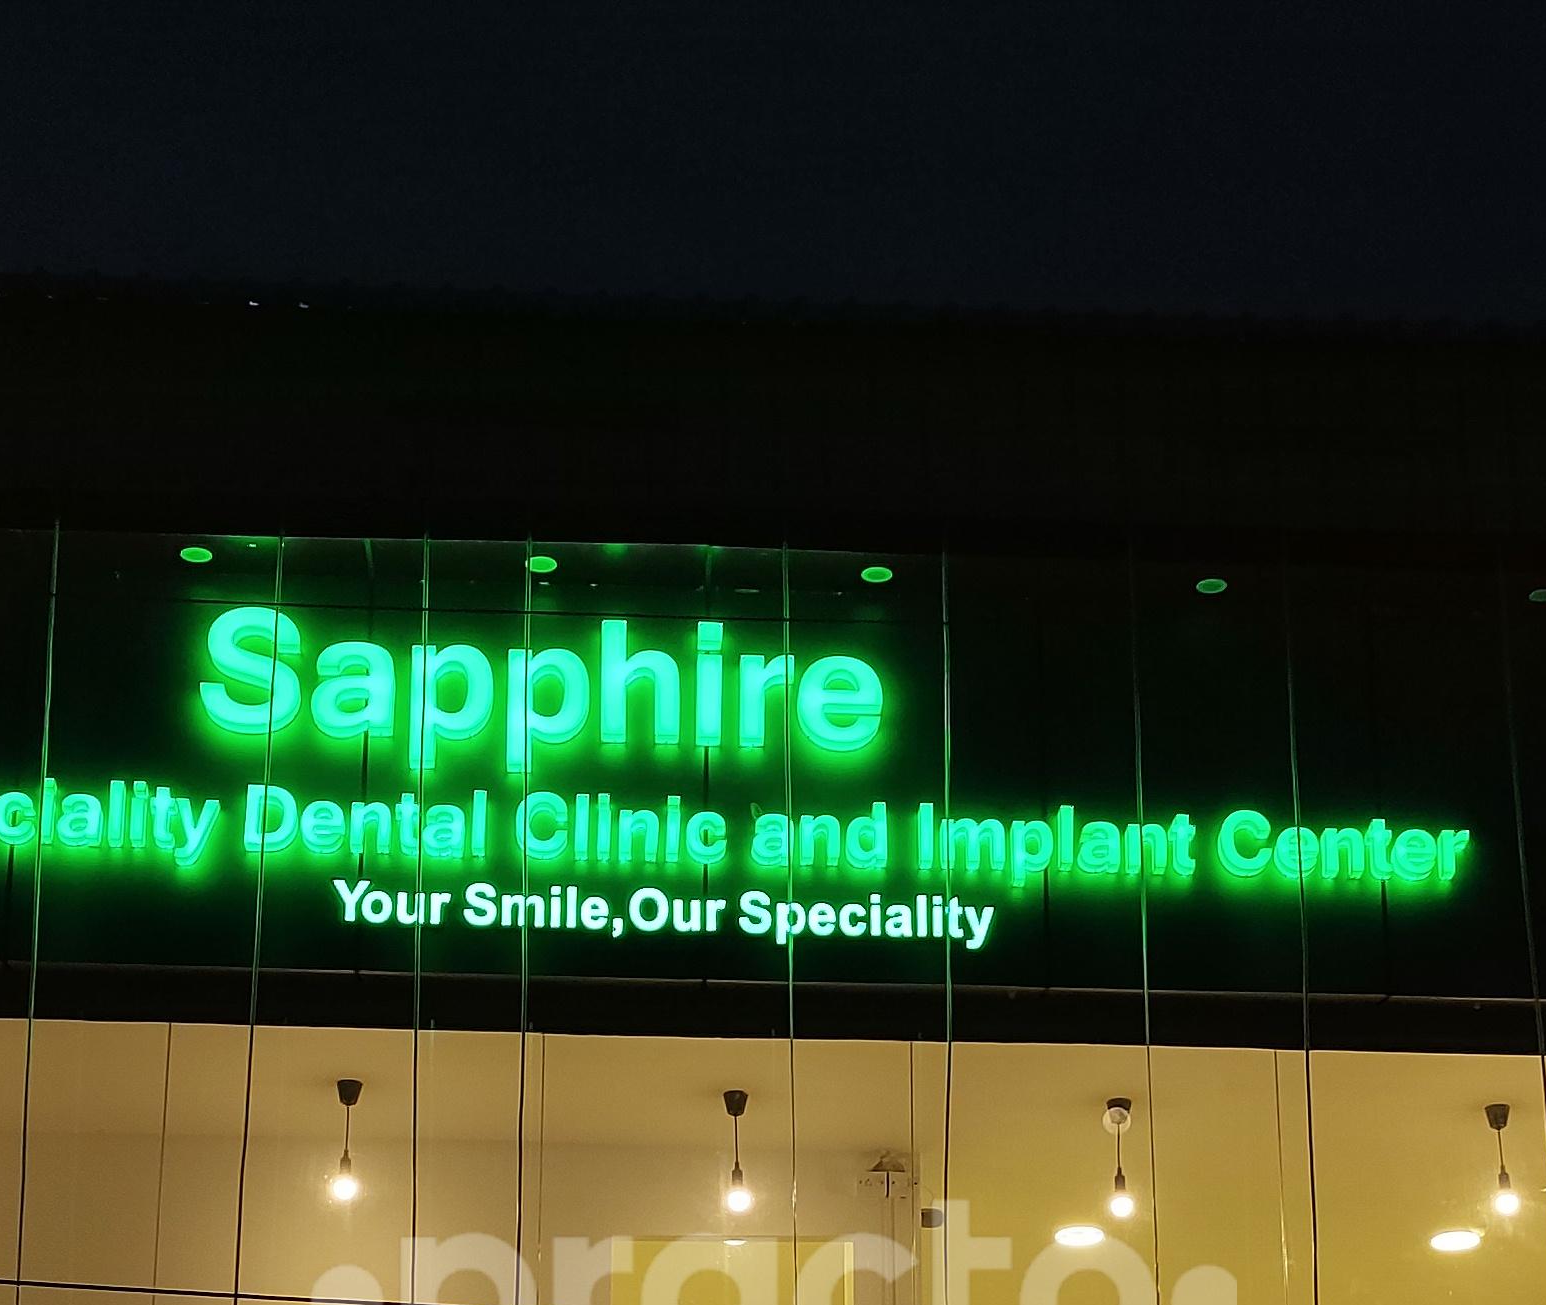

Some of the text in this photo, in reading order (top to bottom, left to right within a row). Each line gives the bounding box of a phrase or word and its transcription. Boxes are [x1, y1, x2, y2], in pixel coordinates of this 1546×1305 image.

[200, 606, 884, 773] Sapphire
[243, 784, 487, 860] Dental
[516, 791, 727, 866] Clinic
[751, 801, 888, 871] and
[918, 801, 1197, 888] Implant
[1217, 810, 1470, 882] Center
[333, 879, 451, 925] Your
[739, 890, 995, 949] Speciality
